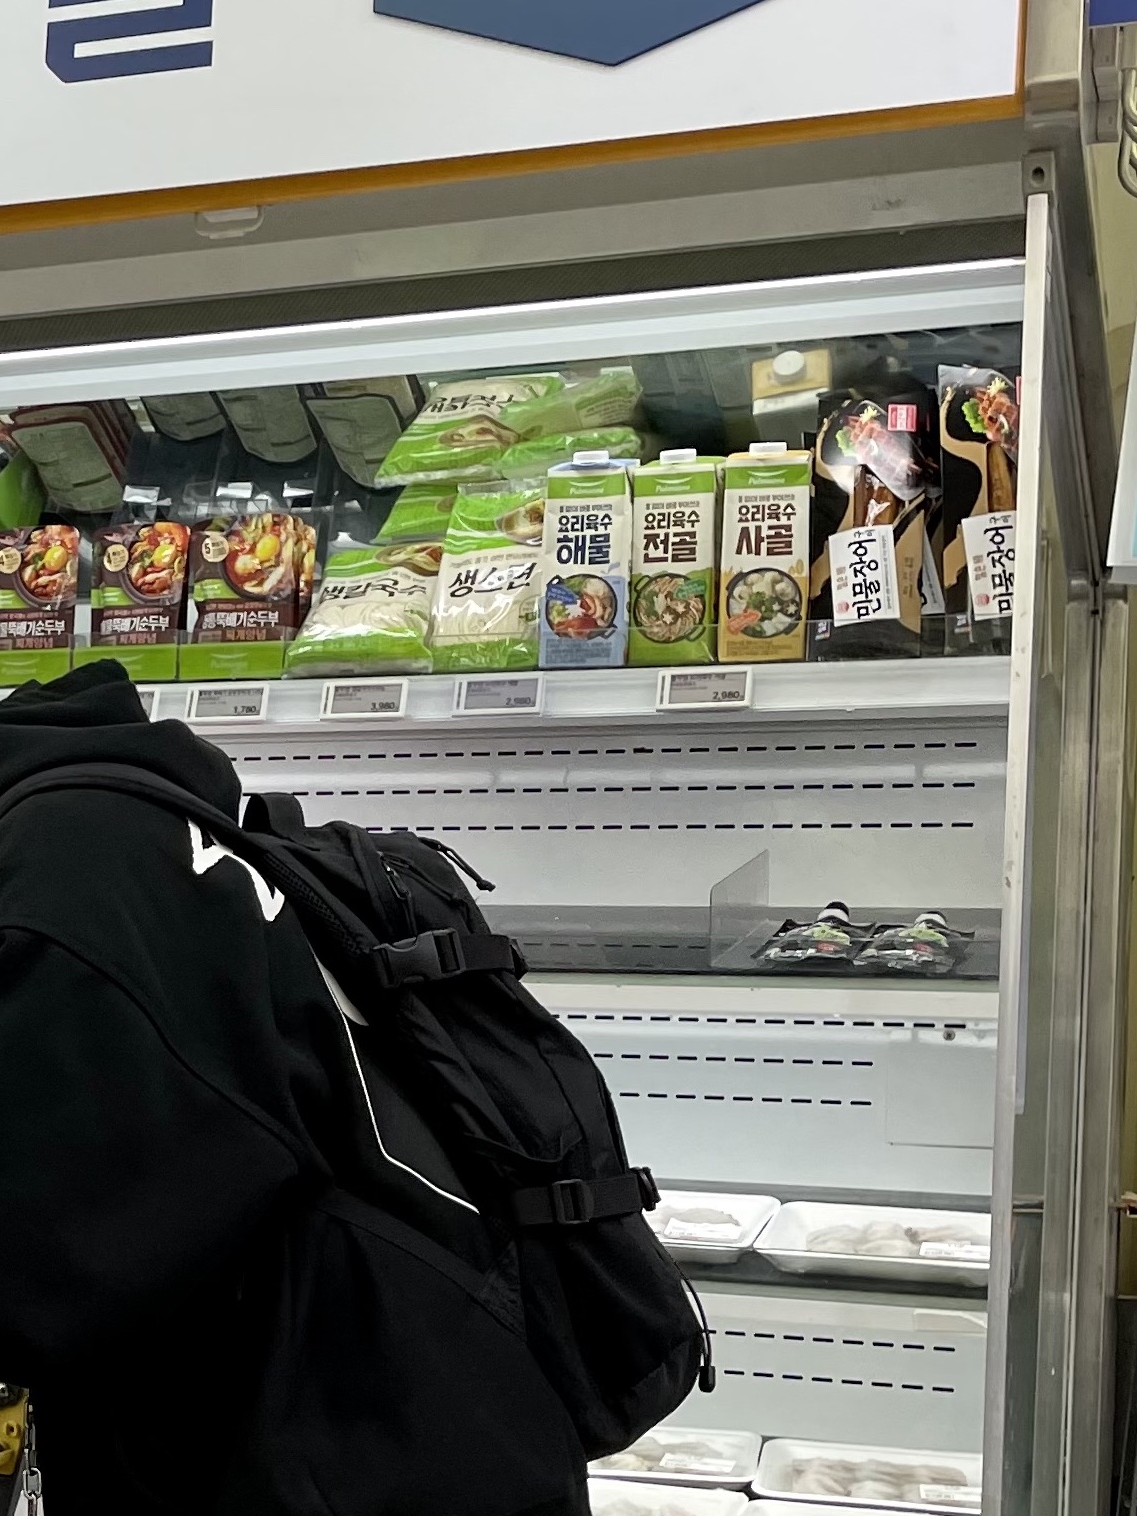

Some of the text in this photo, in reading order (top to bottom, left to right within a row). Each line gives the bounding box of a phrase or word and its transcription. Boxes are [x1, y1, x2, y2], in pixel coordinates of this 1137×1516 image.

[557, 512, 613, 533] 요리육수
[643, 510, 700, 530] 요리육수
[737, 502, 796, 523] 요리육수
[556, 532, 611, 565] 해물
[643, 531, 698, 564] 전골
[735, 524, 794, 556] 사골
[848, 538, 882, 619] 민물장어
